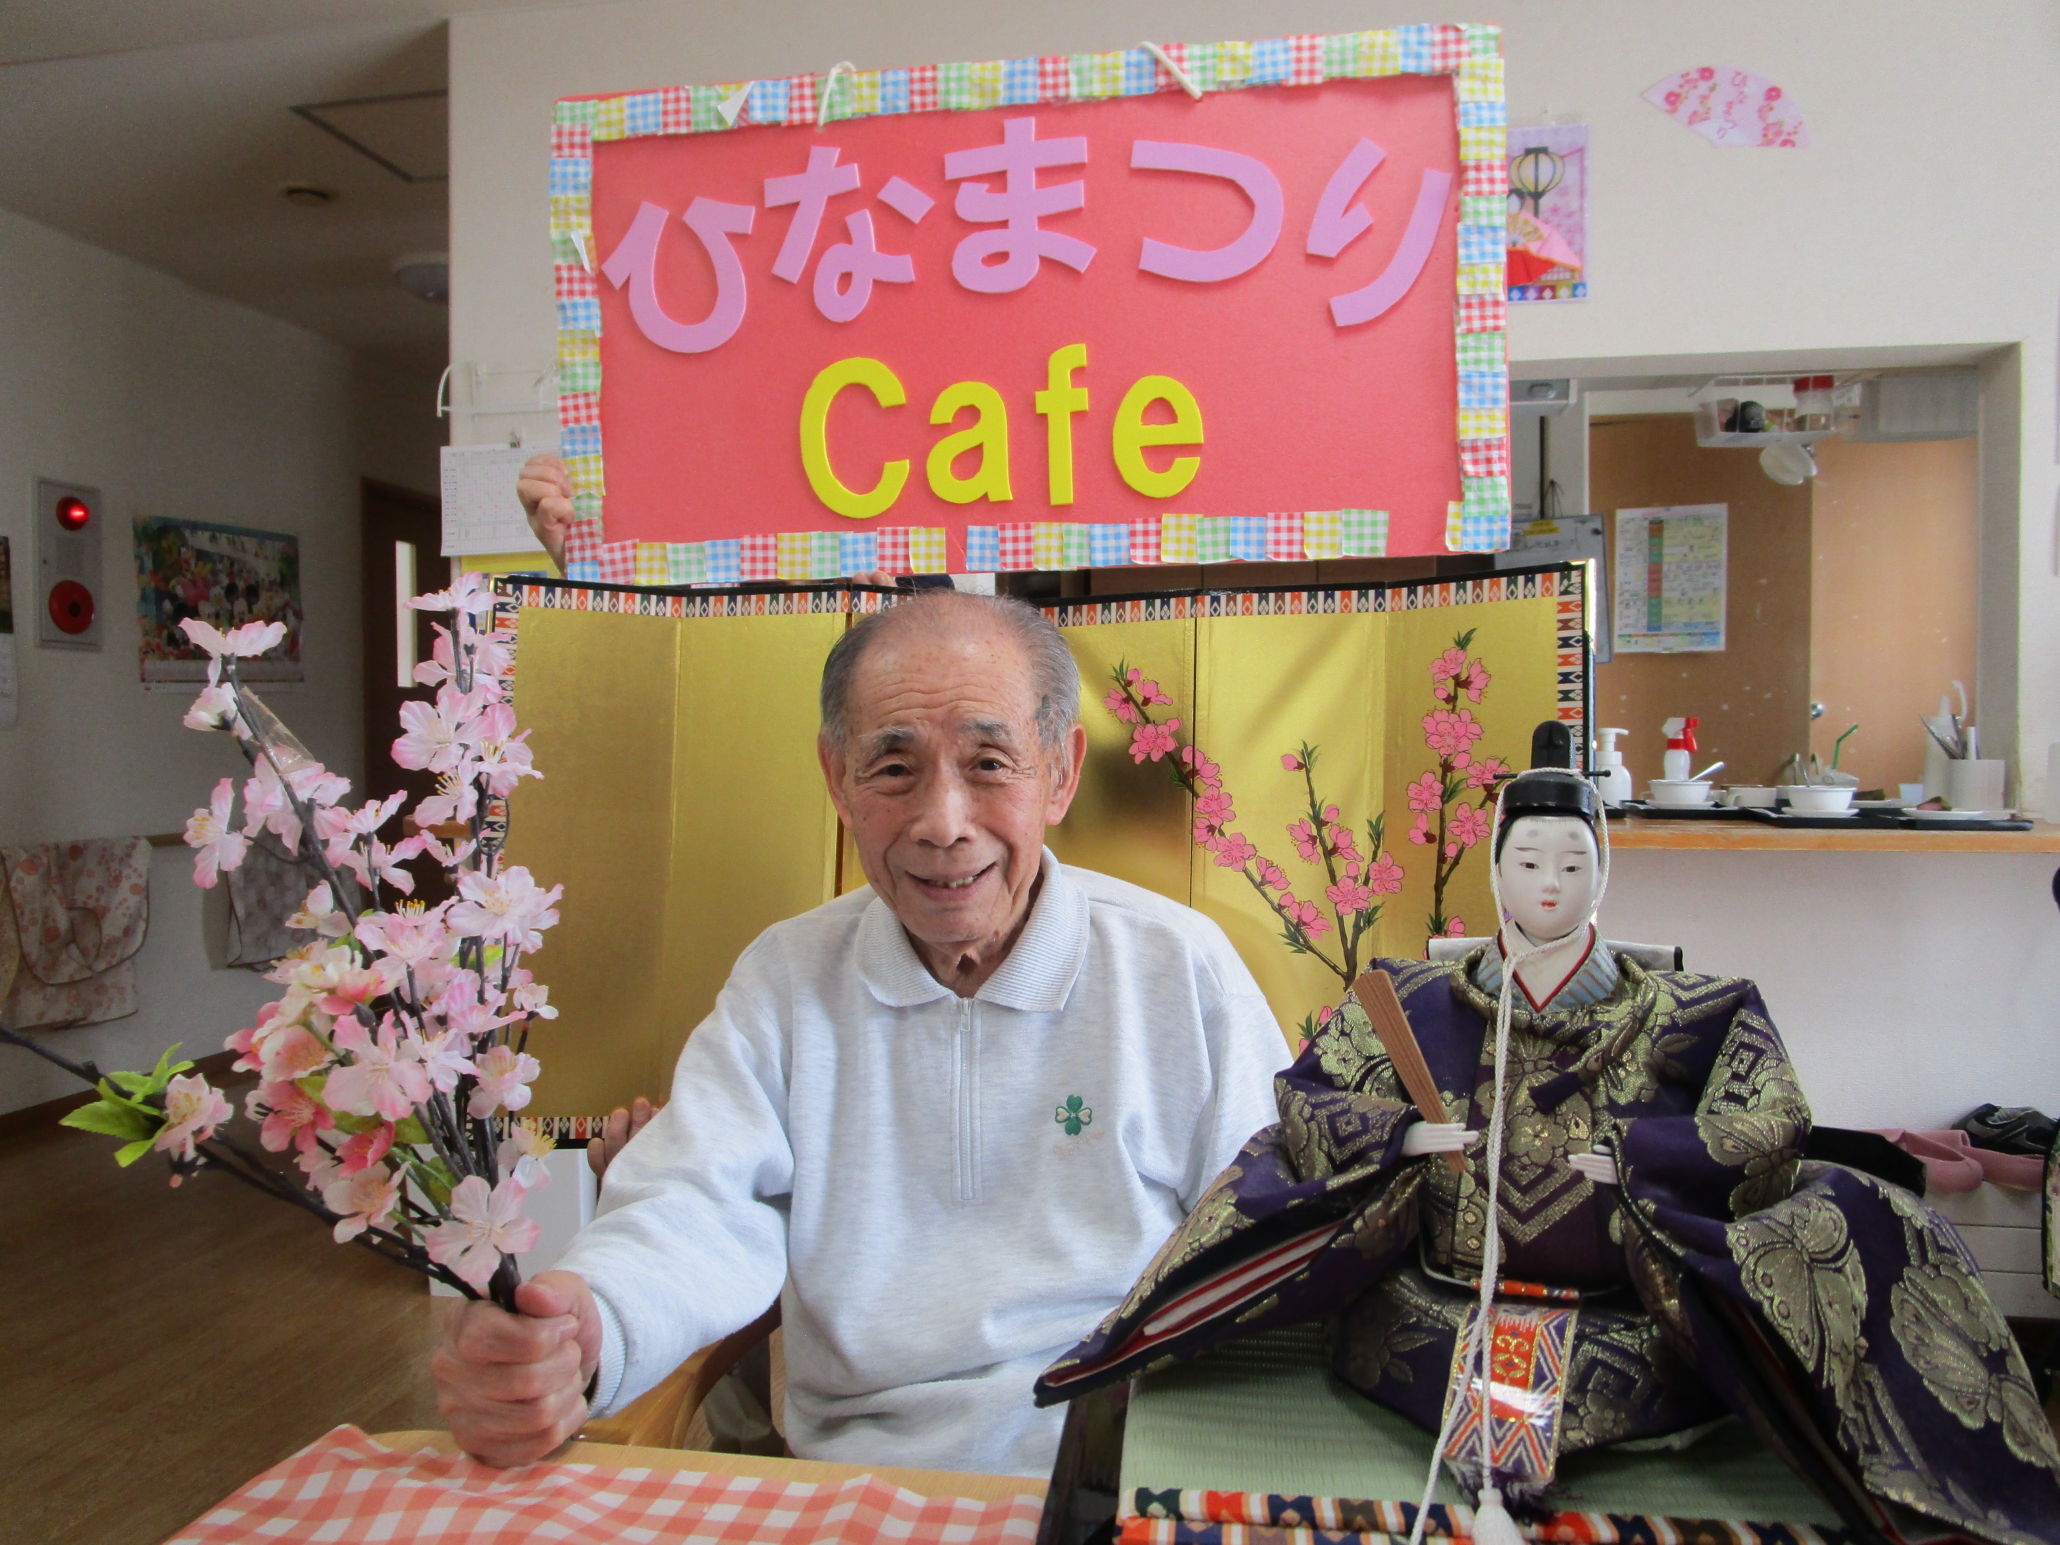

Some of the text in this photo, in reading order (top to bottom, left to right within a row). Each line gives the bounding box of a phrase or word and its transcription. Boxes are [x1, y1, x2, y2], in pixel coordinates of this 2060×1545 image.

[602, 117, 1452, 353] ひなまつり
[800, 343, 1204, 519] Cafe
